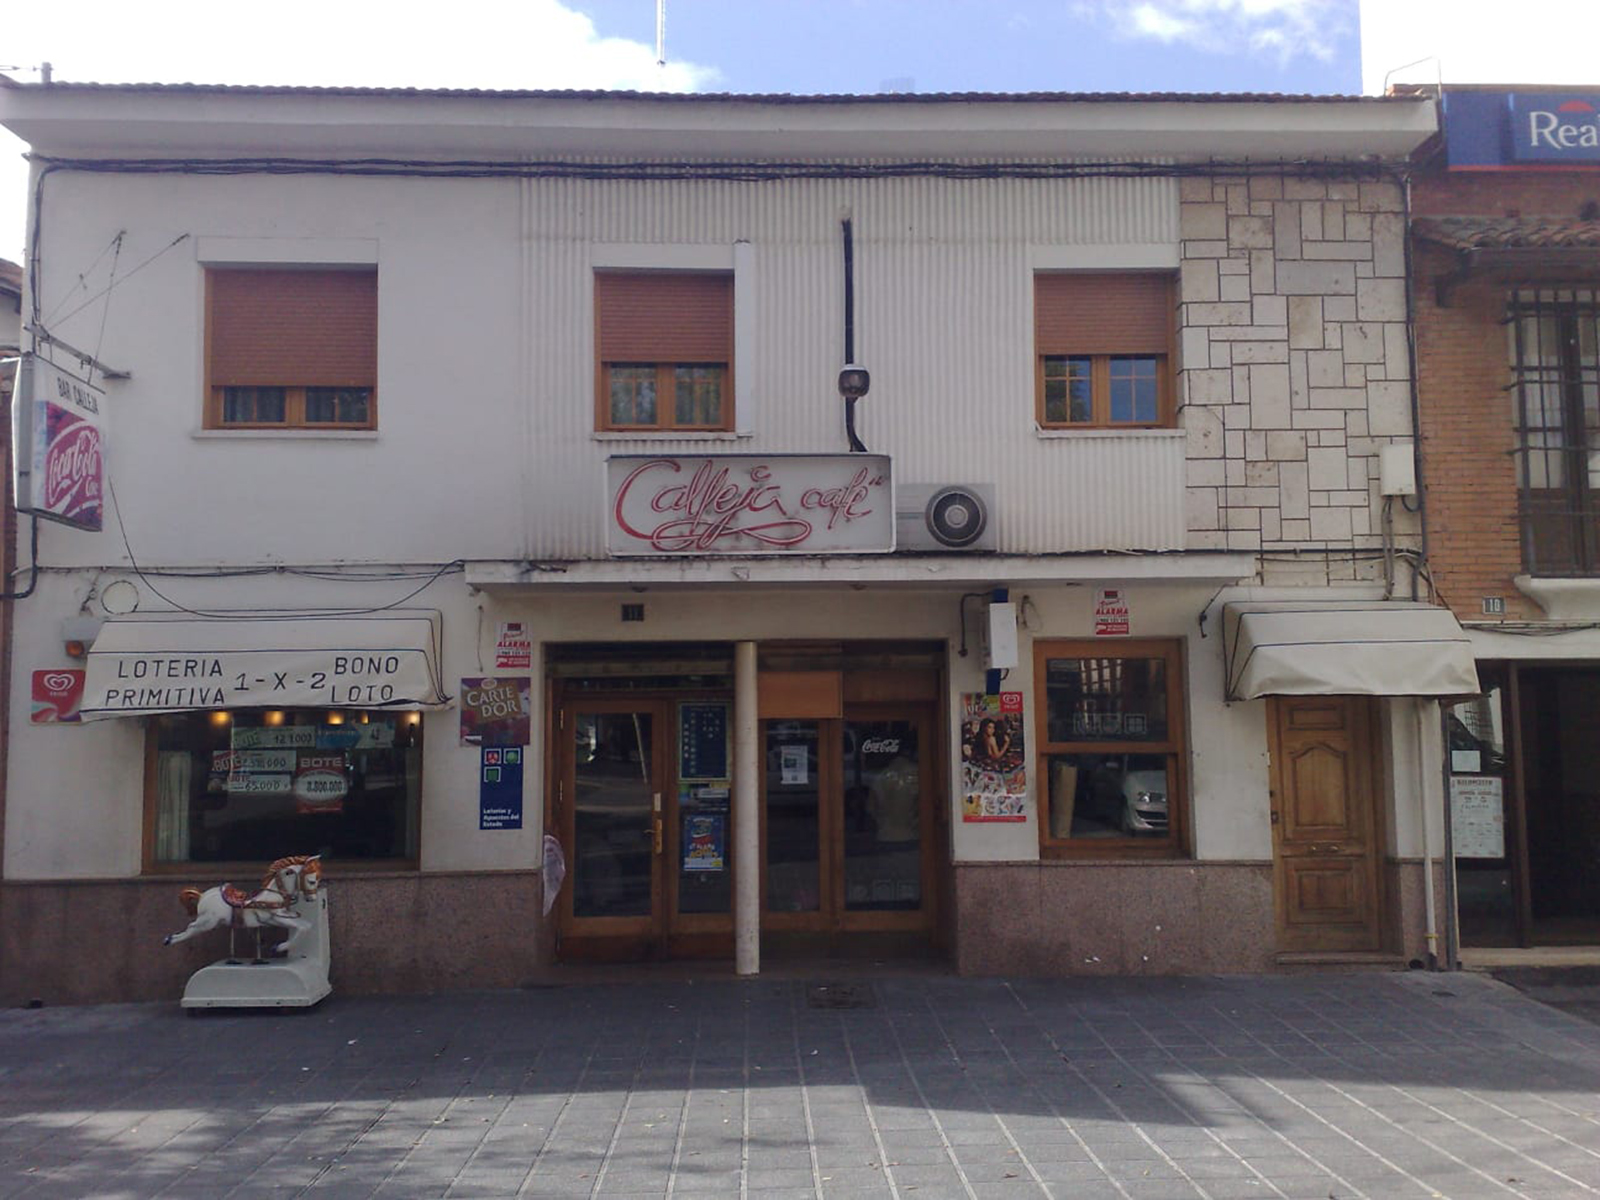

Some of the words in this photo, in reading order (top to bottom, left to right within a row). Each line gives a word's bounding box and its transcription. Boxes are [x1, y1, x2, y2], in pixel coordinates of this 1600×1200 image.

[1529, 111, 1600, 150] Rea
[57, 377, 71, 401] BAR
[72, 385, 99, 416] CALLEJA
[118, 659, 223, 680] LOTERIA
[334, 656, 400, 676] BONO
[105, 687, 226, 707] PRIMITIVA
[331, 685, 394, 704] LOTO
[467, 687, 515, 706] CARTE
[481, 700, 519, 718] D'OR
[300, 757, 343, 768] BOTE
